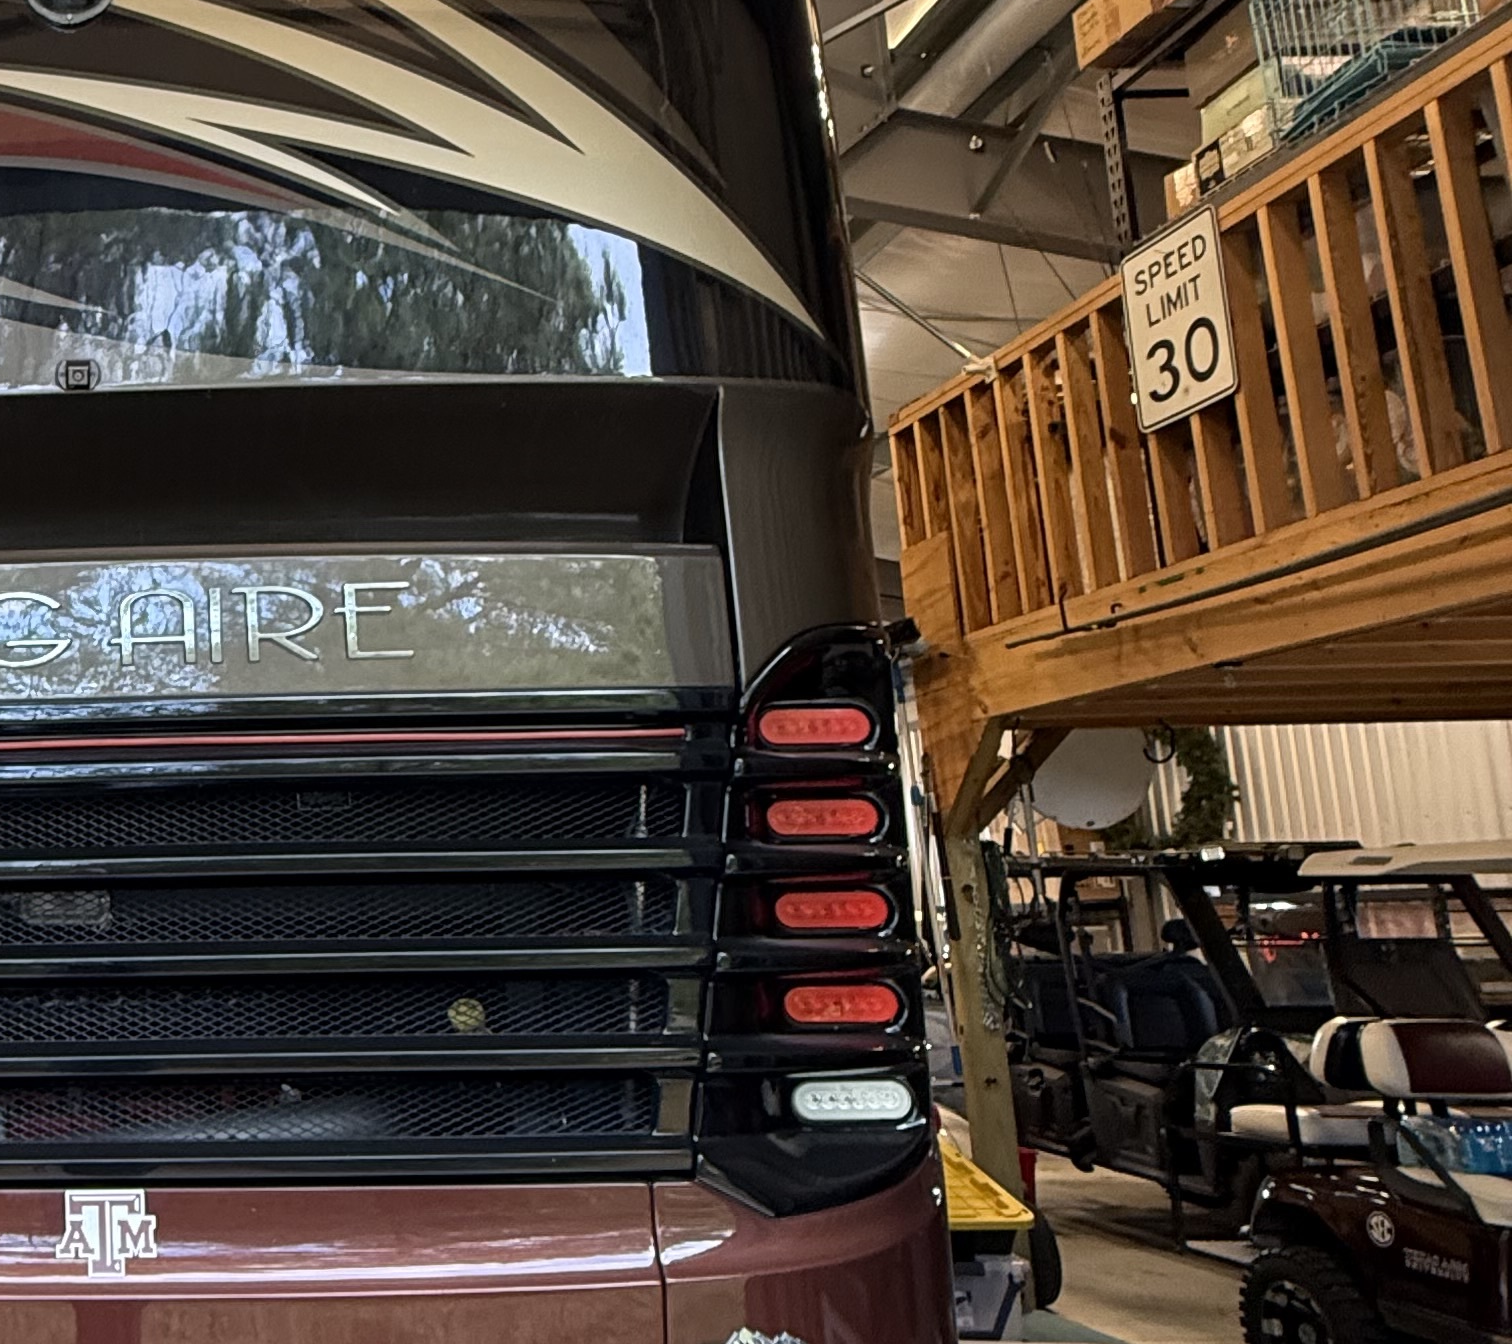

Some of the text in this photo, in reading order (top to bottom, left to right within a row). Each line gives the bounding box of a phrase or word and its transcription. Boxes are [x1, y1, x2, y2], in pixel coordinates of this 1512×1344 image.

[1134, 234, 1207, 296] SPEED
[1145, 274, 1202, 328] LIMIT
[1146, 317, 1219, 402] 30
[110, 581, 414, 665] AIRE
